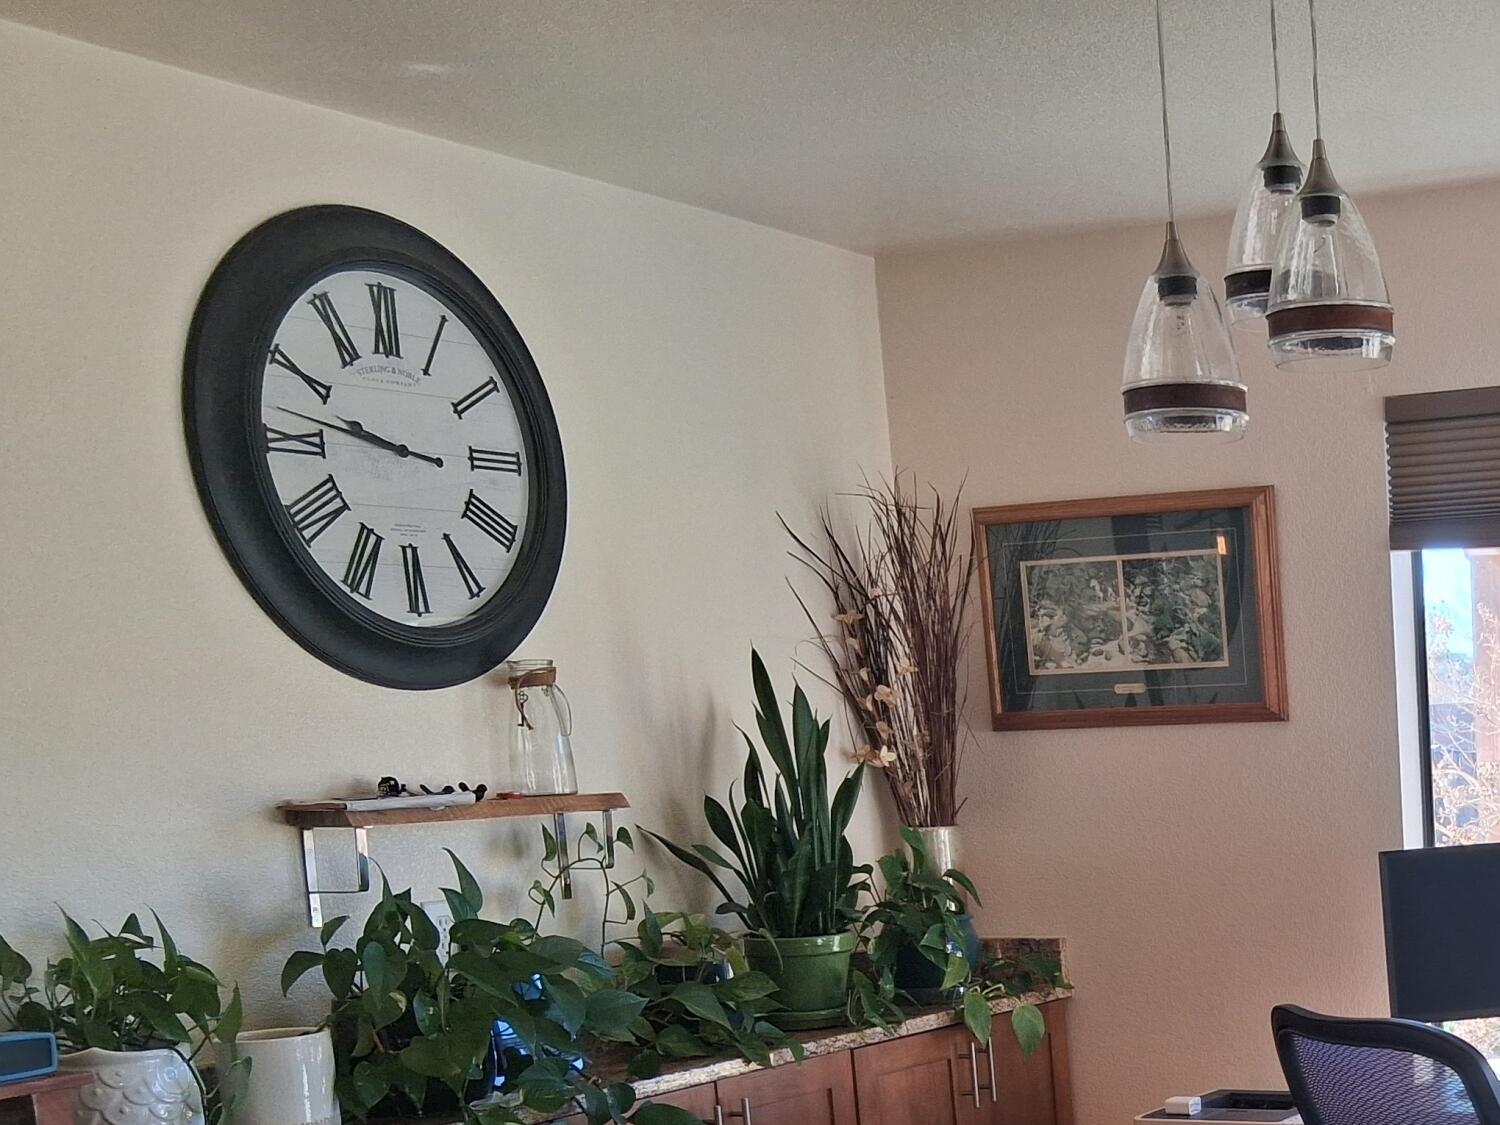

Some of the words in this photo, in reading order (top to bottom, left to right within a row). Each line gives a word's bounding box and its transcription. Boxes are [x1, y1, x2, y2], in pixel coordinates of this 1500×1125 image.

[307, 291, 362, 369] XI
[365, 282, 404, 358] XII
[267, 343, 333, 405] X
[451, 376, 500, 420] II
[264, 424, 326, 459] IX
[468, 445, 522, 477] III
[283, 473, 352, 549] VIII
[341, 522, 385, 600] VII
[399, 543, 433, 617] VI
[441, 533, 486, 600] V
